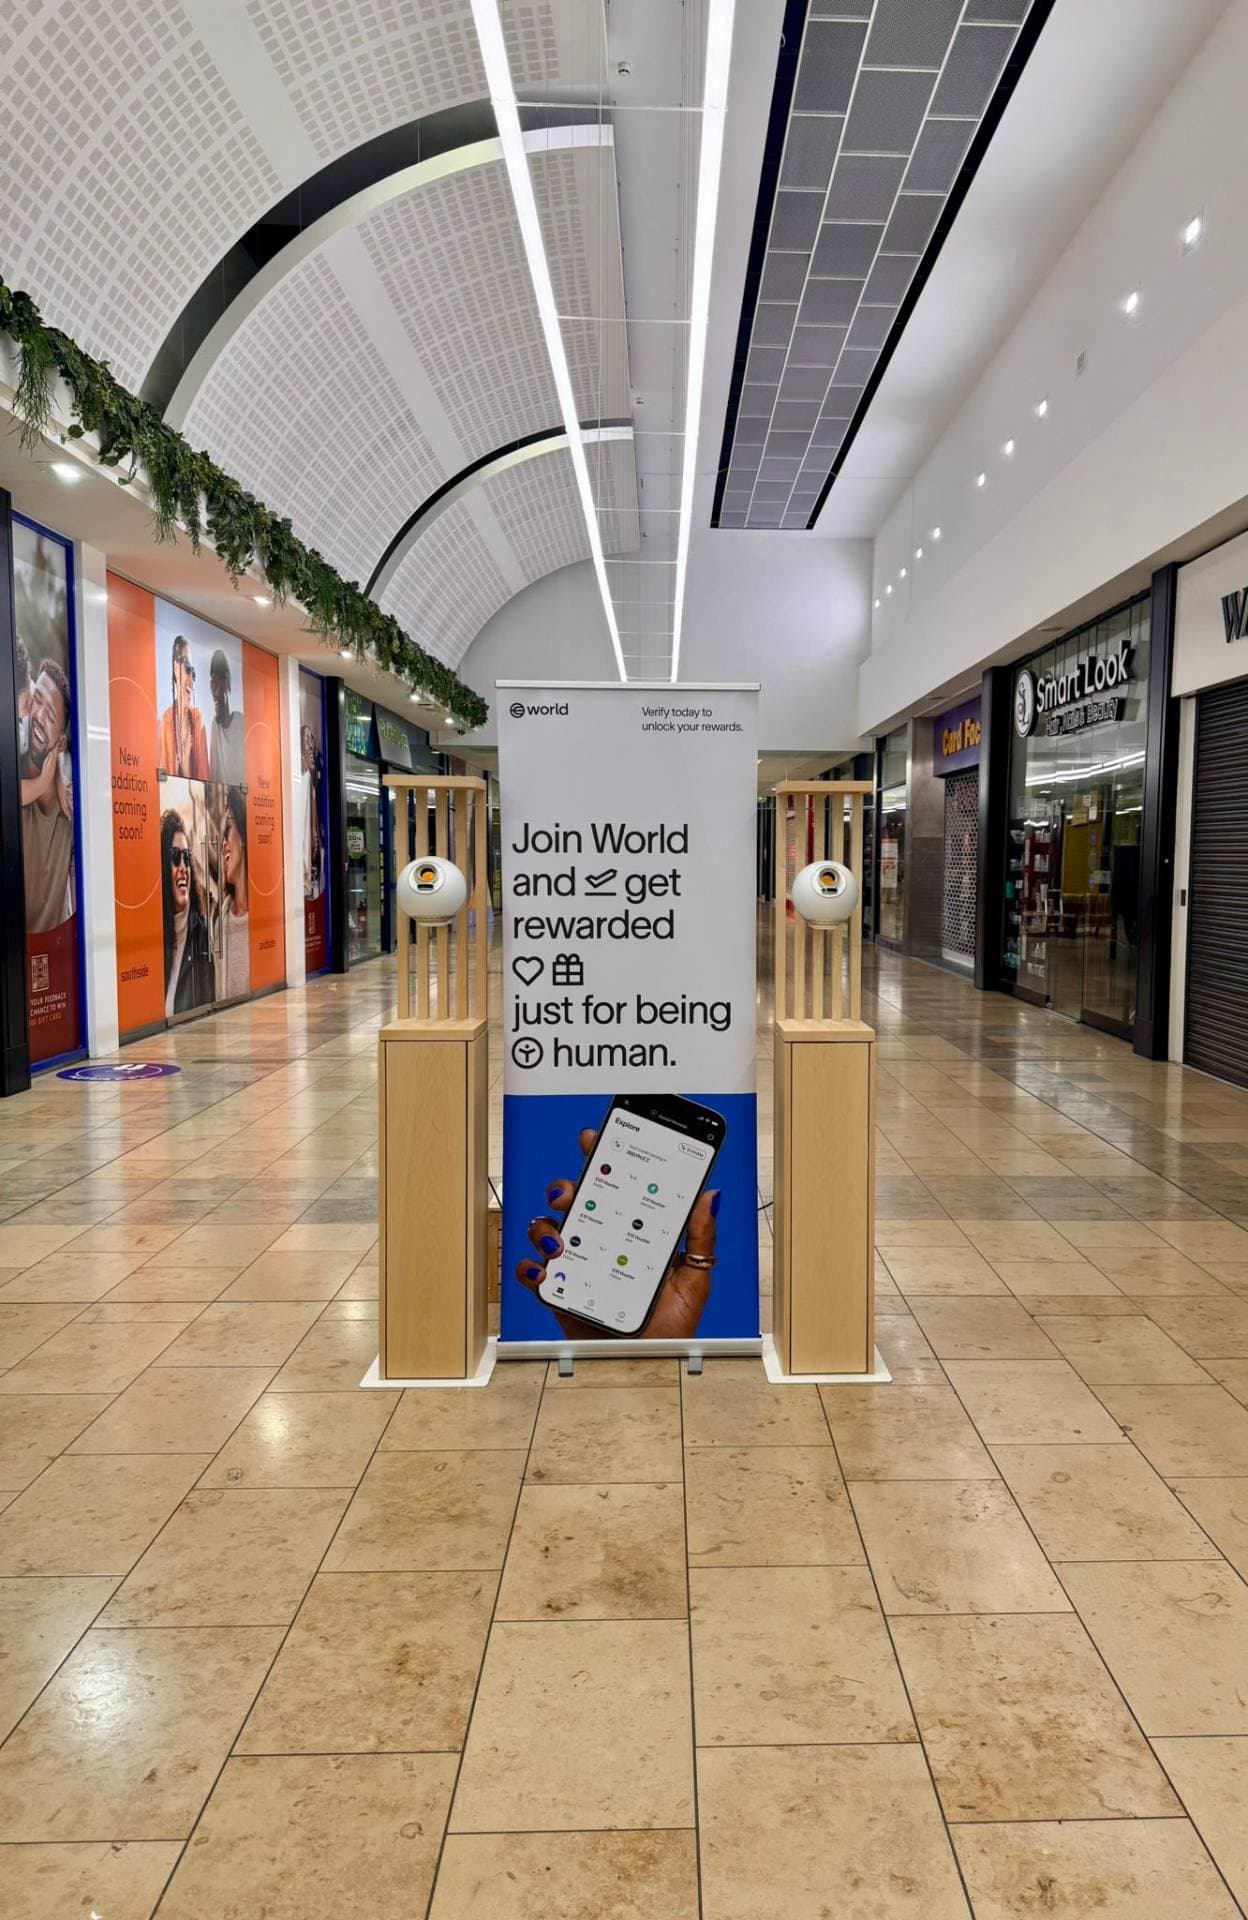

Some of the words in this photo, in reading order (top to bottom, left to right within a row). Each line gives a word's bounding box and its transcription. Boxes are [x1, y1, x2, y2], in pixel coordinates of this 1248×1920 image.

[1037, 668, 1080, 713] Smart
[1084, 640, 1128, 694] Look
[527, 702, 569, 716] world
[641, 707, 670, 719] Verify
[672, 707, 700, 719] today
[701, 708, 713, 718] to
[1087, 698, 1119, 724] Beauty
[642, 722, 676, 733] unlock
[677, 723, 700, 735] your
[701, 722, 744, 733] rewards.
[943, 721, 962, 756] Card
[119, 747, 139, 768] New
[112, 771, 149, 793] addition
[113, 798, 147, 822] coming
[119, 822, 144, 841] soon!
[512, 822, 582, 854] Join
[591, 822, 689, 854] World
[513, 865, 576, 897] and
[625, 869, 682, 905] get
[513, 909, 674, 940] rewarded
[121, 964, 149, 982] southside
[30, 1005, 50, 1017] CHANCE
[512, 995, 574, 1033] just
[582, 994, 627, 1025] for
[637, 994, 731, 1032] being
[554, 1037, 677, 1068] human.
[615, 1117, 640, 1132] Explore
